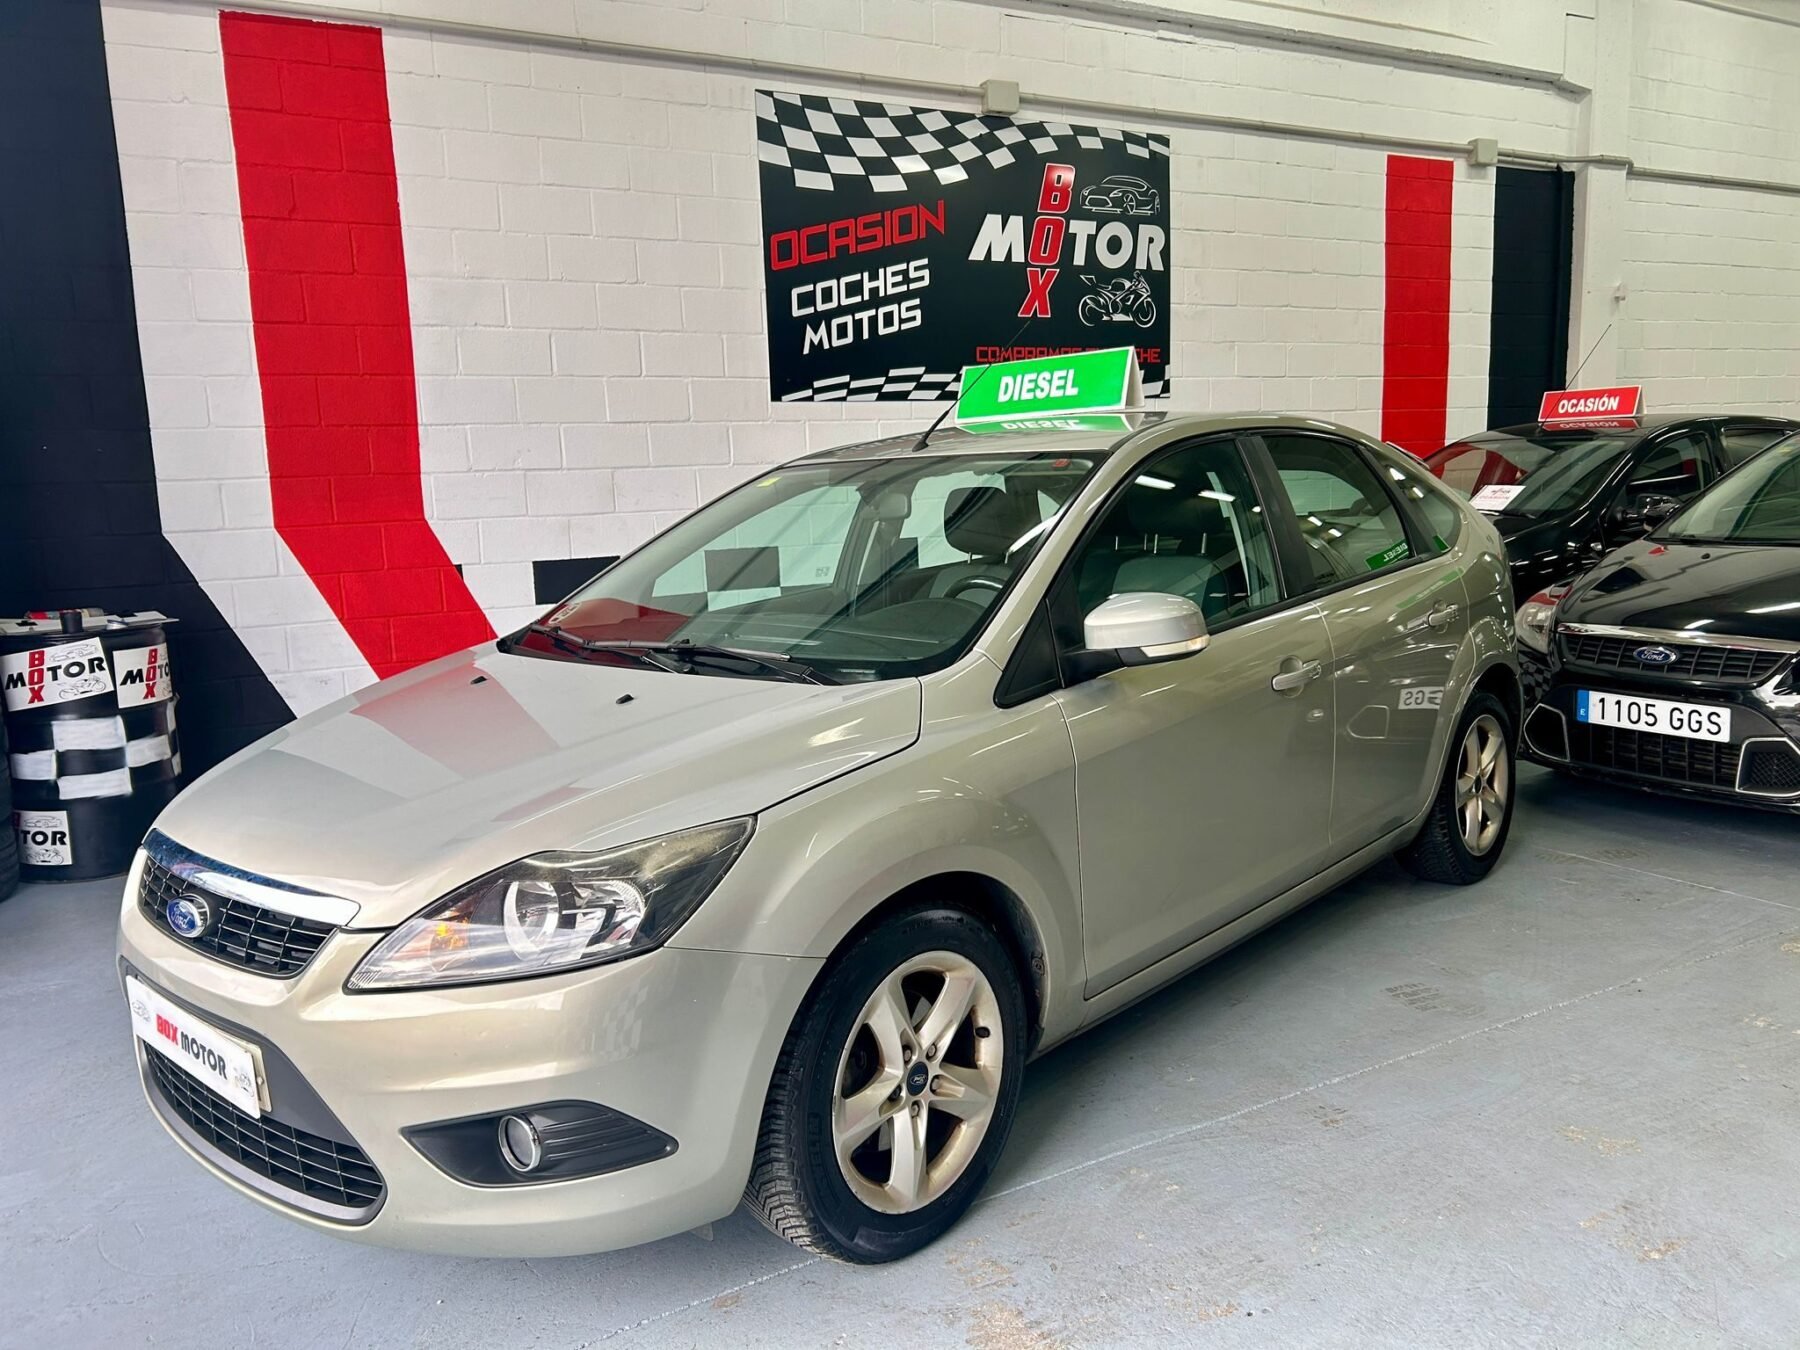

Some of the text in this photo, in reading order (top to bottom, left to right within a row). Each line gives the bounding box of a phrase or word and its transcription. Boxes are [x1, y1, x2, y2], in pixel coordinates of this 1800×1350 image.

[770, 199, 946, 271] OCASION
[967, 213, 1166, 271] MOTOR
[1017, 163, 1076, 318] BOX
[791, 257, 930, 317] COCHES
[803, 298, 922, 355] MOTOS
[997, 369, 1079, 402] DIESEL
[1558, 394, 1619, 414] OCASIÓN
[5, 656, 106, 690] MOTOR
[28, 650, 45, 704] BOX
[120, 662, 169, 686] MOTO
[144, 648, 158, 700] BOX
[1580, 708, 1585, 716] E
[1598, 697, 1722, 736] 1105 GGS
[20, 830, 67, 846] TOR
[171, 903, 191, 929] Ford
[156, 1013, 228, 1081] BOX MOTOR
